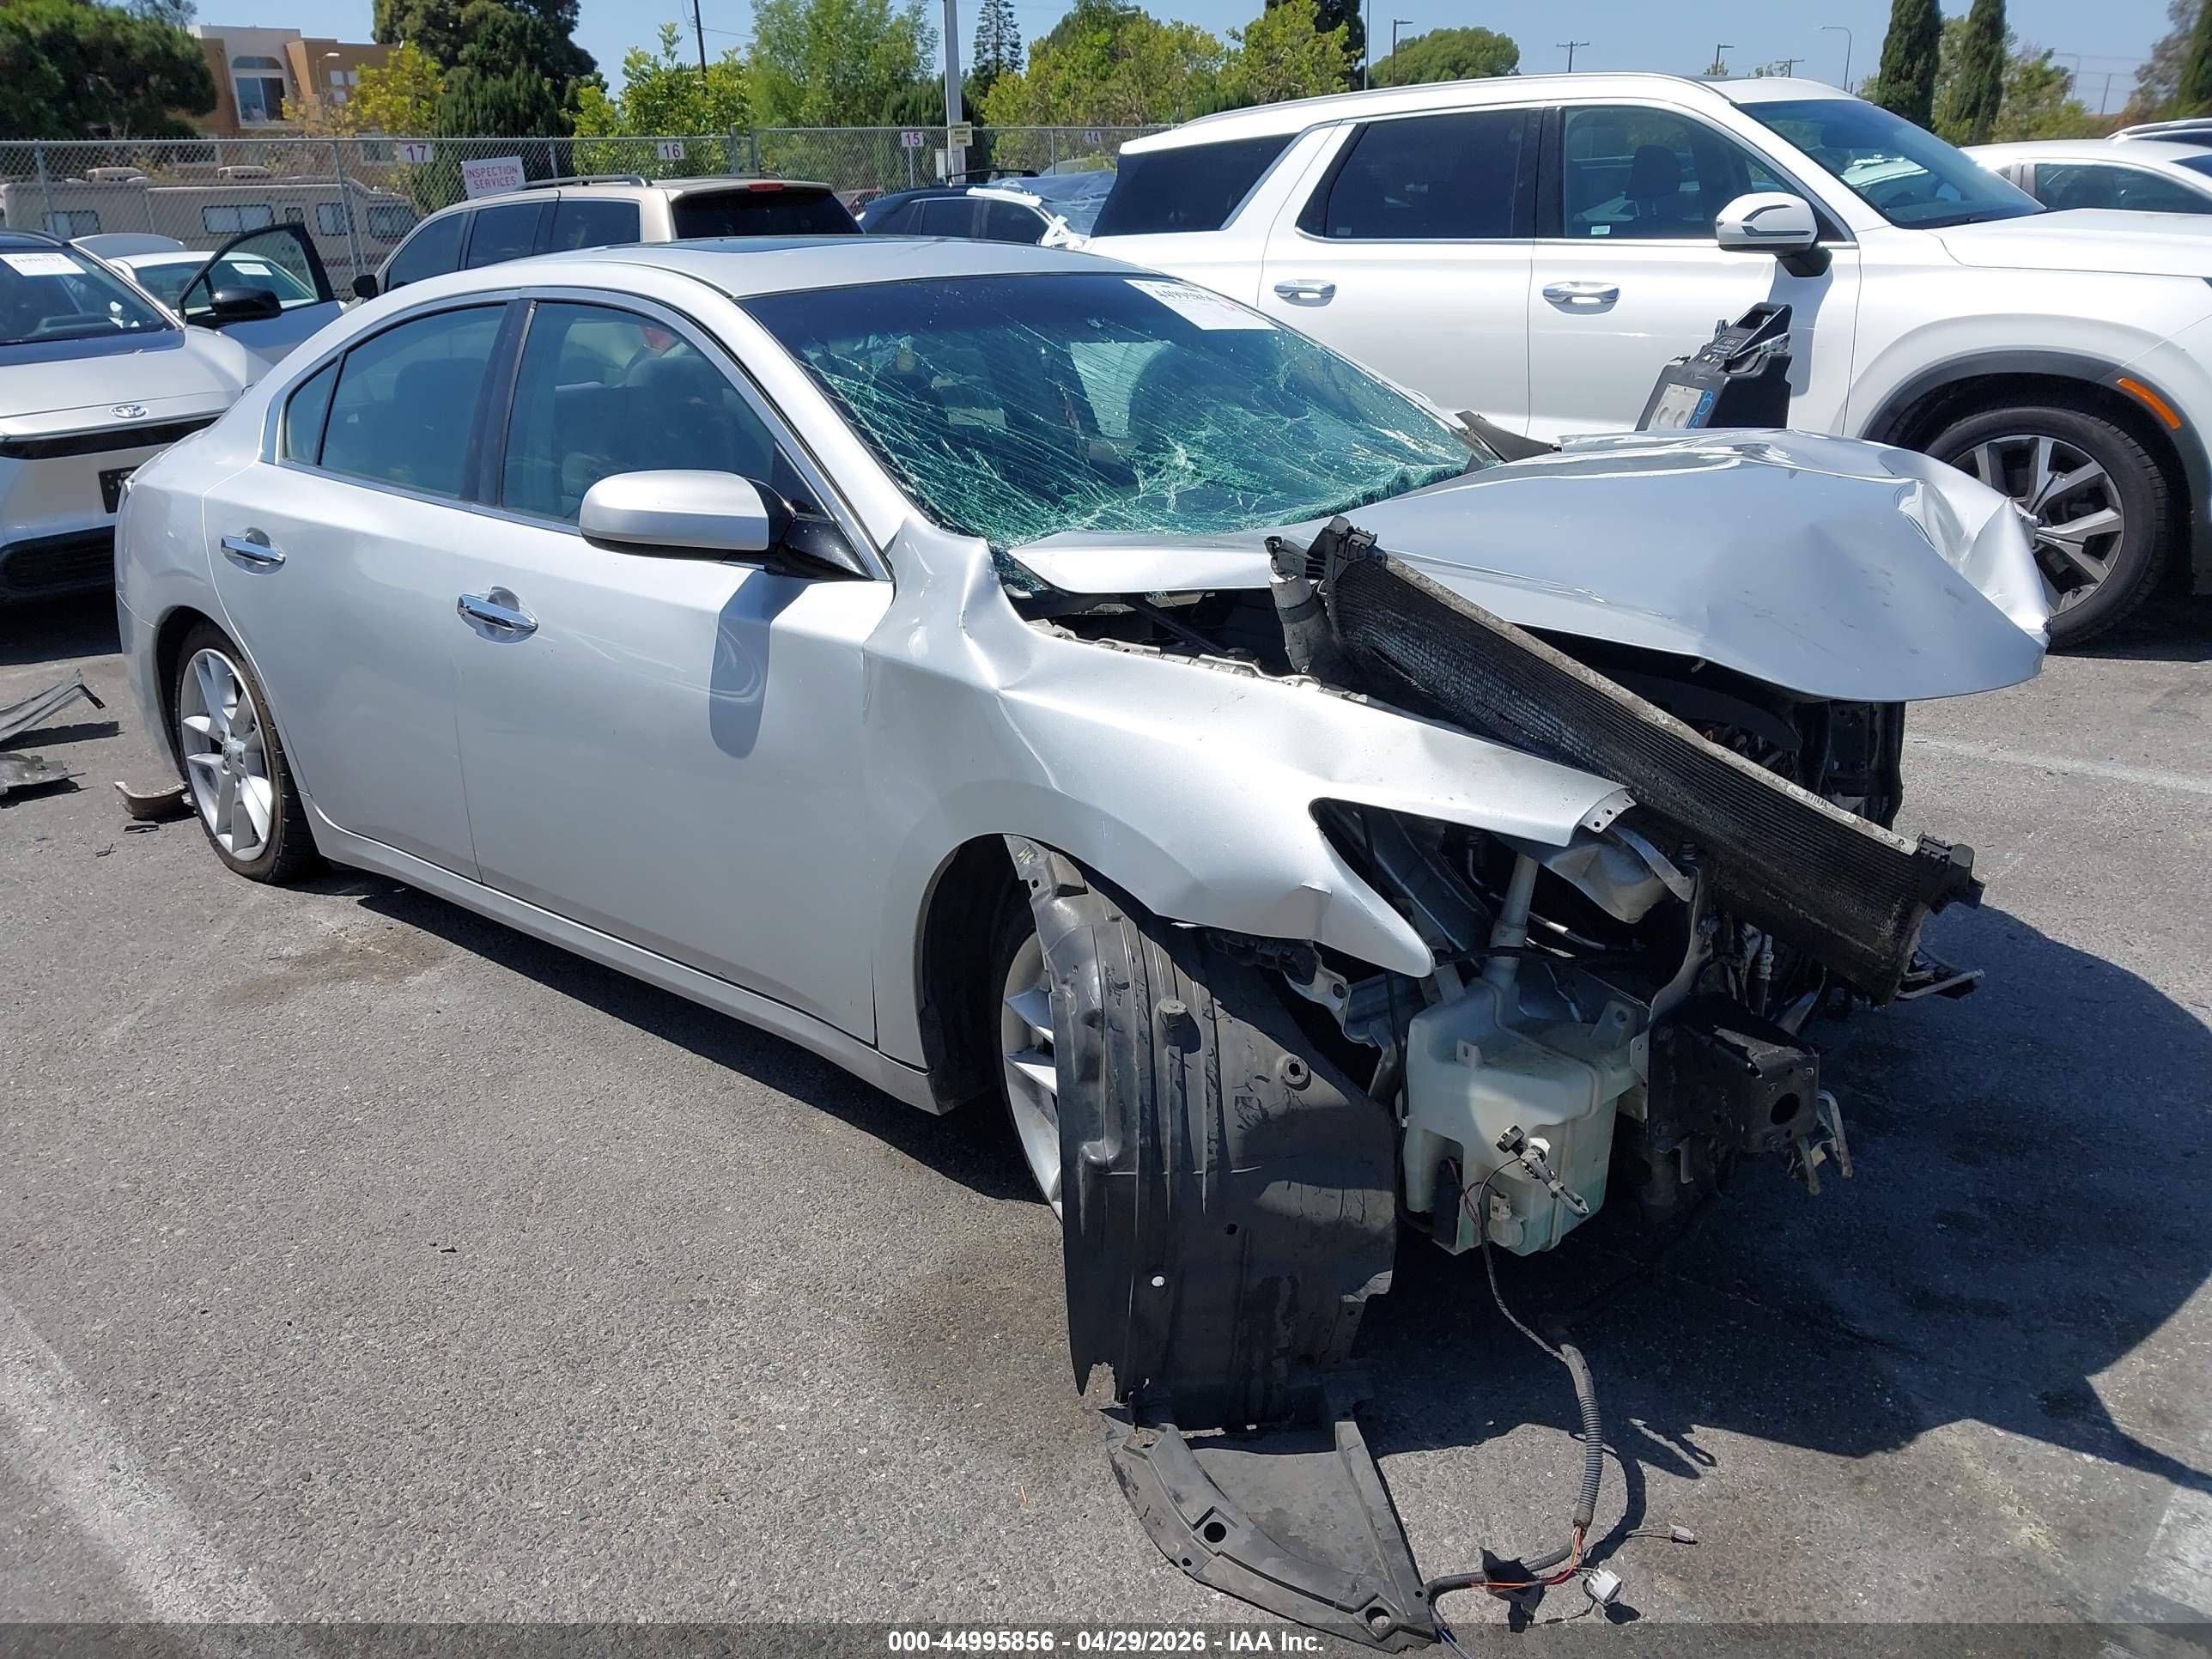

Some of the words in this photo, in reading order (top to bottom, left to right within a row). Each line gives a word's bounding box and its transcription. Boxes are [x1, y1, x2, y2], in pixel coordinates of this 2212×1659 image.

[905, 131, 921, 146] 15
[1088, 131, 1099, 144] 14
[405, 144, 427, 161] 17
[663, 143, 681, 159] 16
[465, 165, 519, 179] INSPECTION
[473, 175, 516, 190] SERVICES
